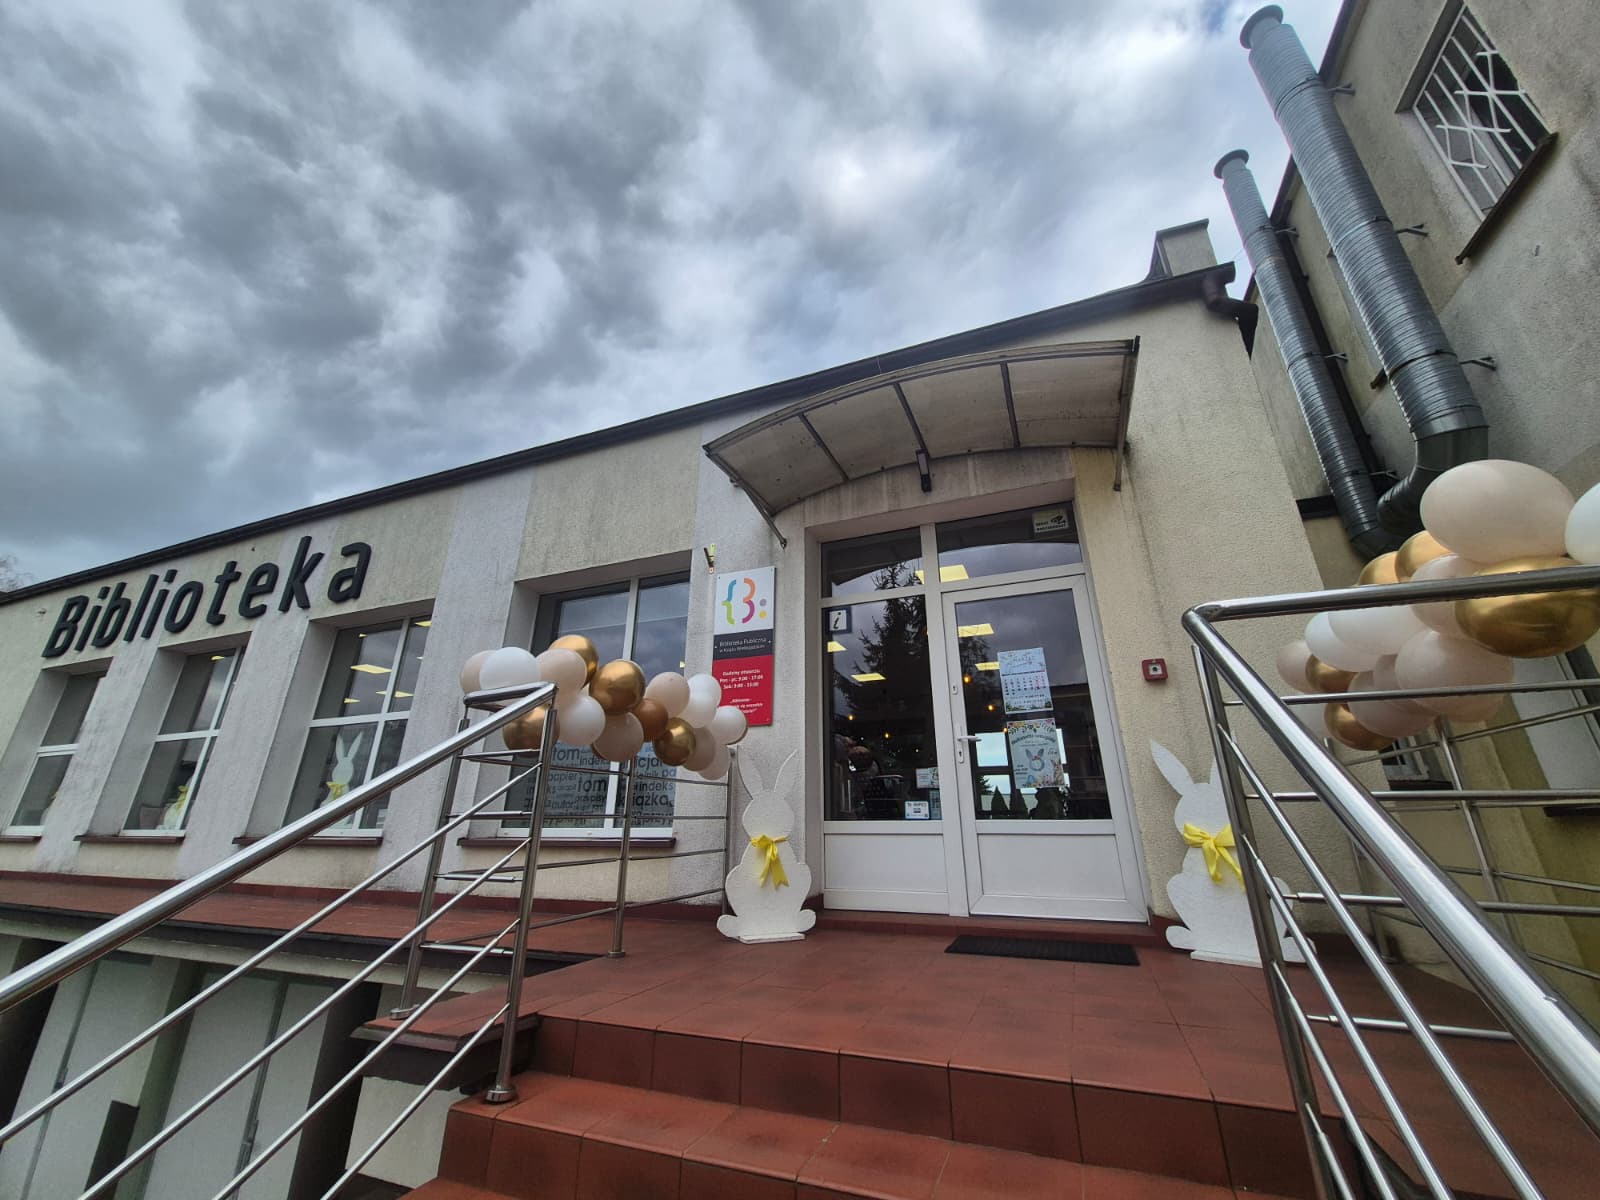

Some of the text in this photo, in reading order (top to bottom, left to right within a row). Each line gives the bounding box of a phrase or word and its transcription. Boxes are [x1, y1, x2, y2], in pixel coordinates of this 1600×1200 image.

[41, 535, 372, 658] Biblioteka
[552, 746, 580, 761] tom
[577, 777, 607, 792] tom
[616, 792, 669, 810] kiążka
